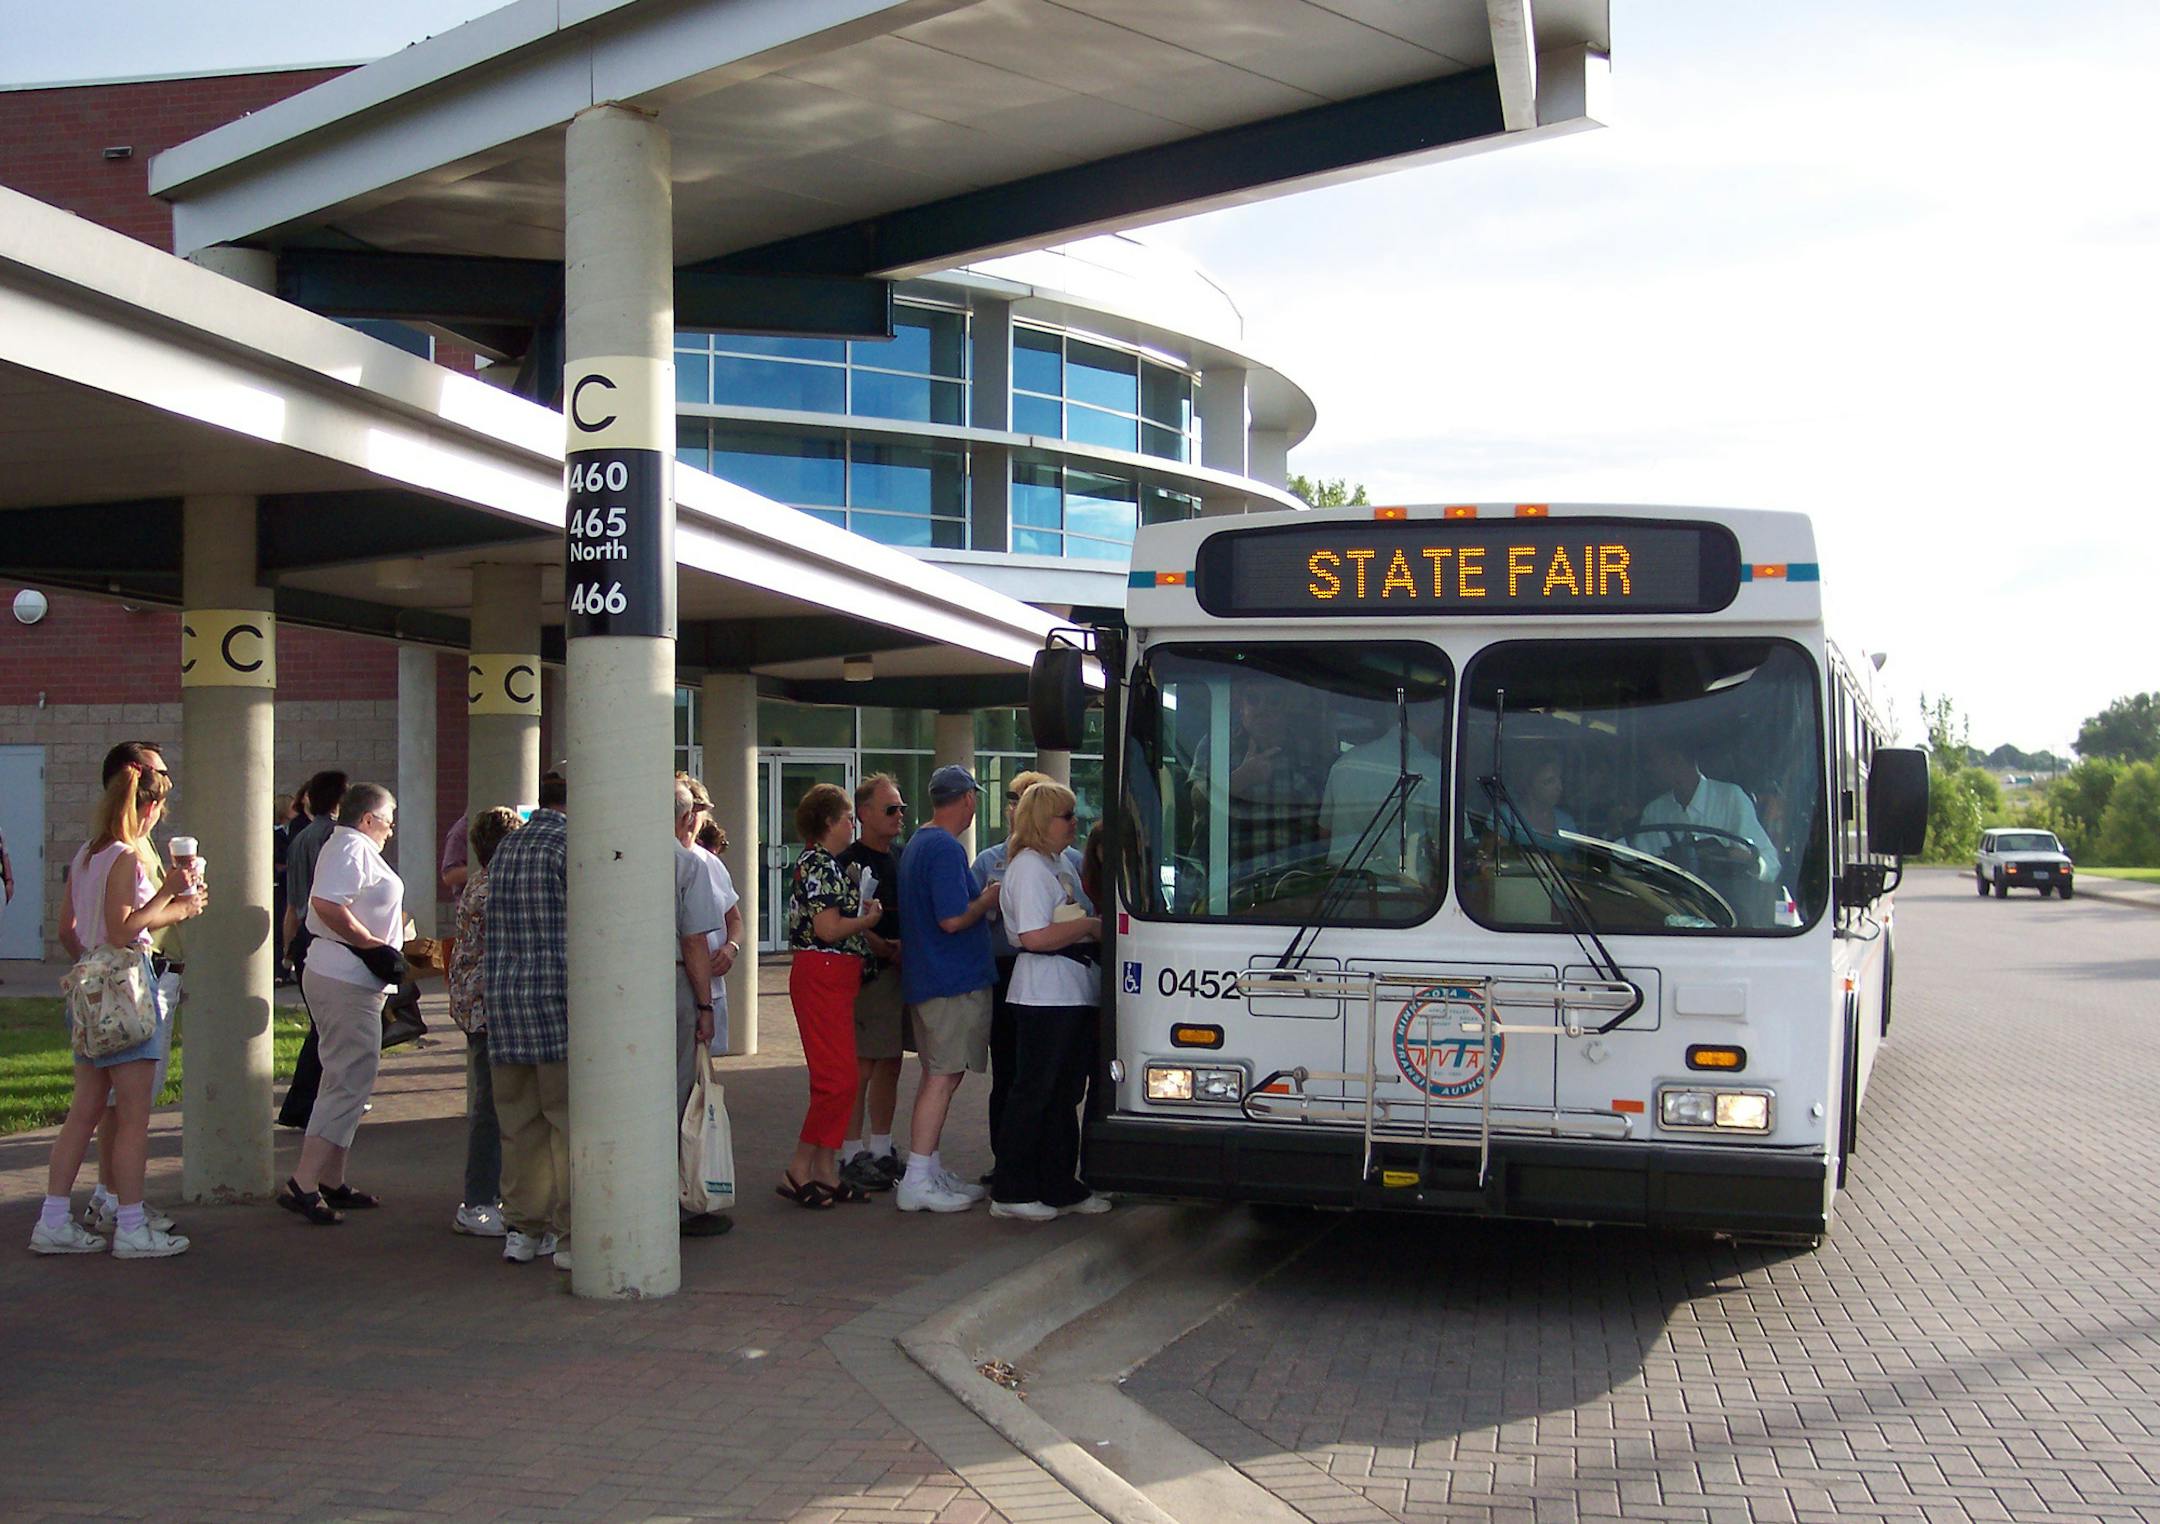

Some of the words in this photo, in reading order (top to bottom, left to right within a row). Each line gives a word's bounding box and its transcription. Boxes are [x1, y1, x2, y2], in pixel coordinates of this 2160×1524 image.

[571, 374, 617, 432] C
[570, 461, 628, 493] 460
[570, 507, 627, 538] 465
[570, 538, 628, 562] North
[1308, 547, 1486, 599] STATE
[1507, 545, 1632, 597] FAIR
[570, 581, 627, 614] 466
[222, 624, 263, 672] C
[505, 665, 535, 703] C
[1158, 968, 1241, 1000] 0452
[1441, 1048, 1500, 1096] AUTHOITY
